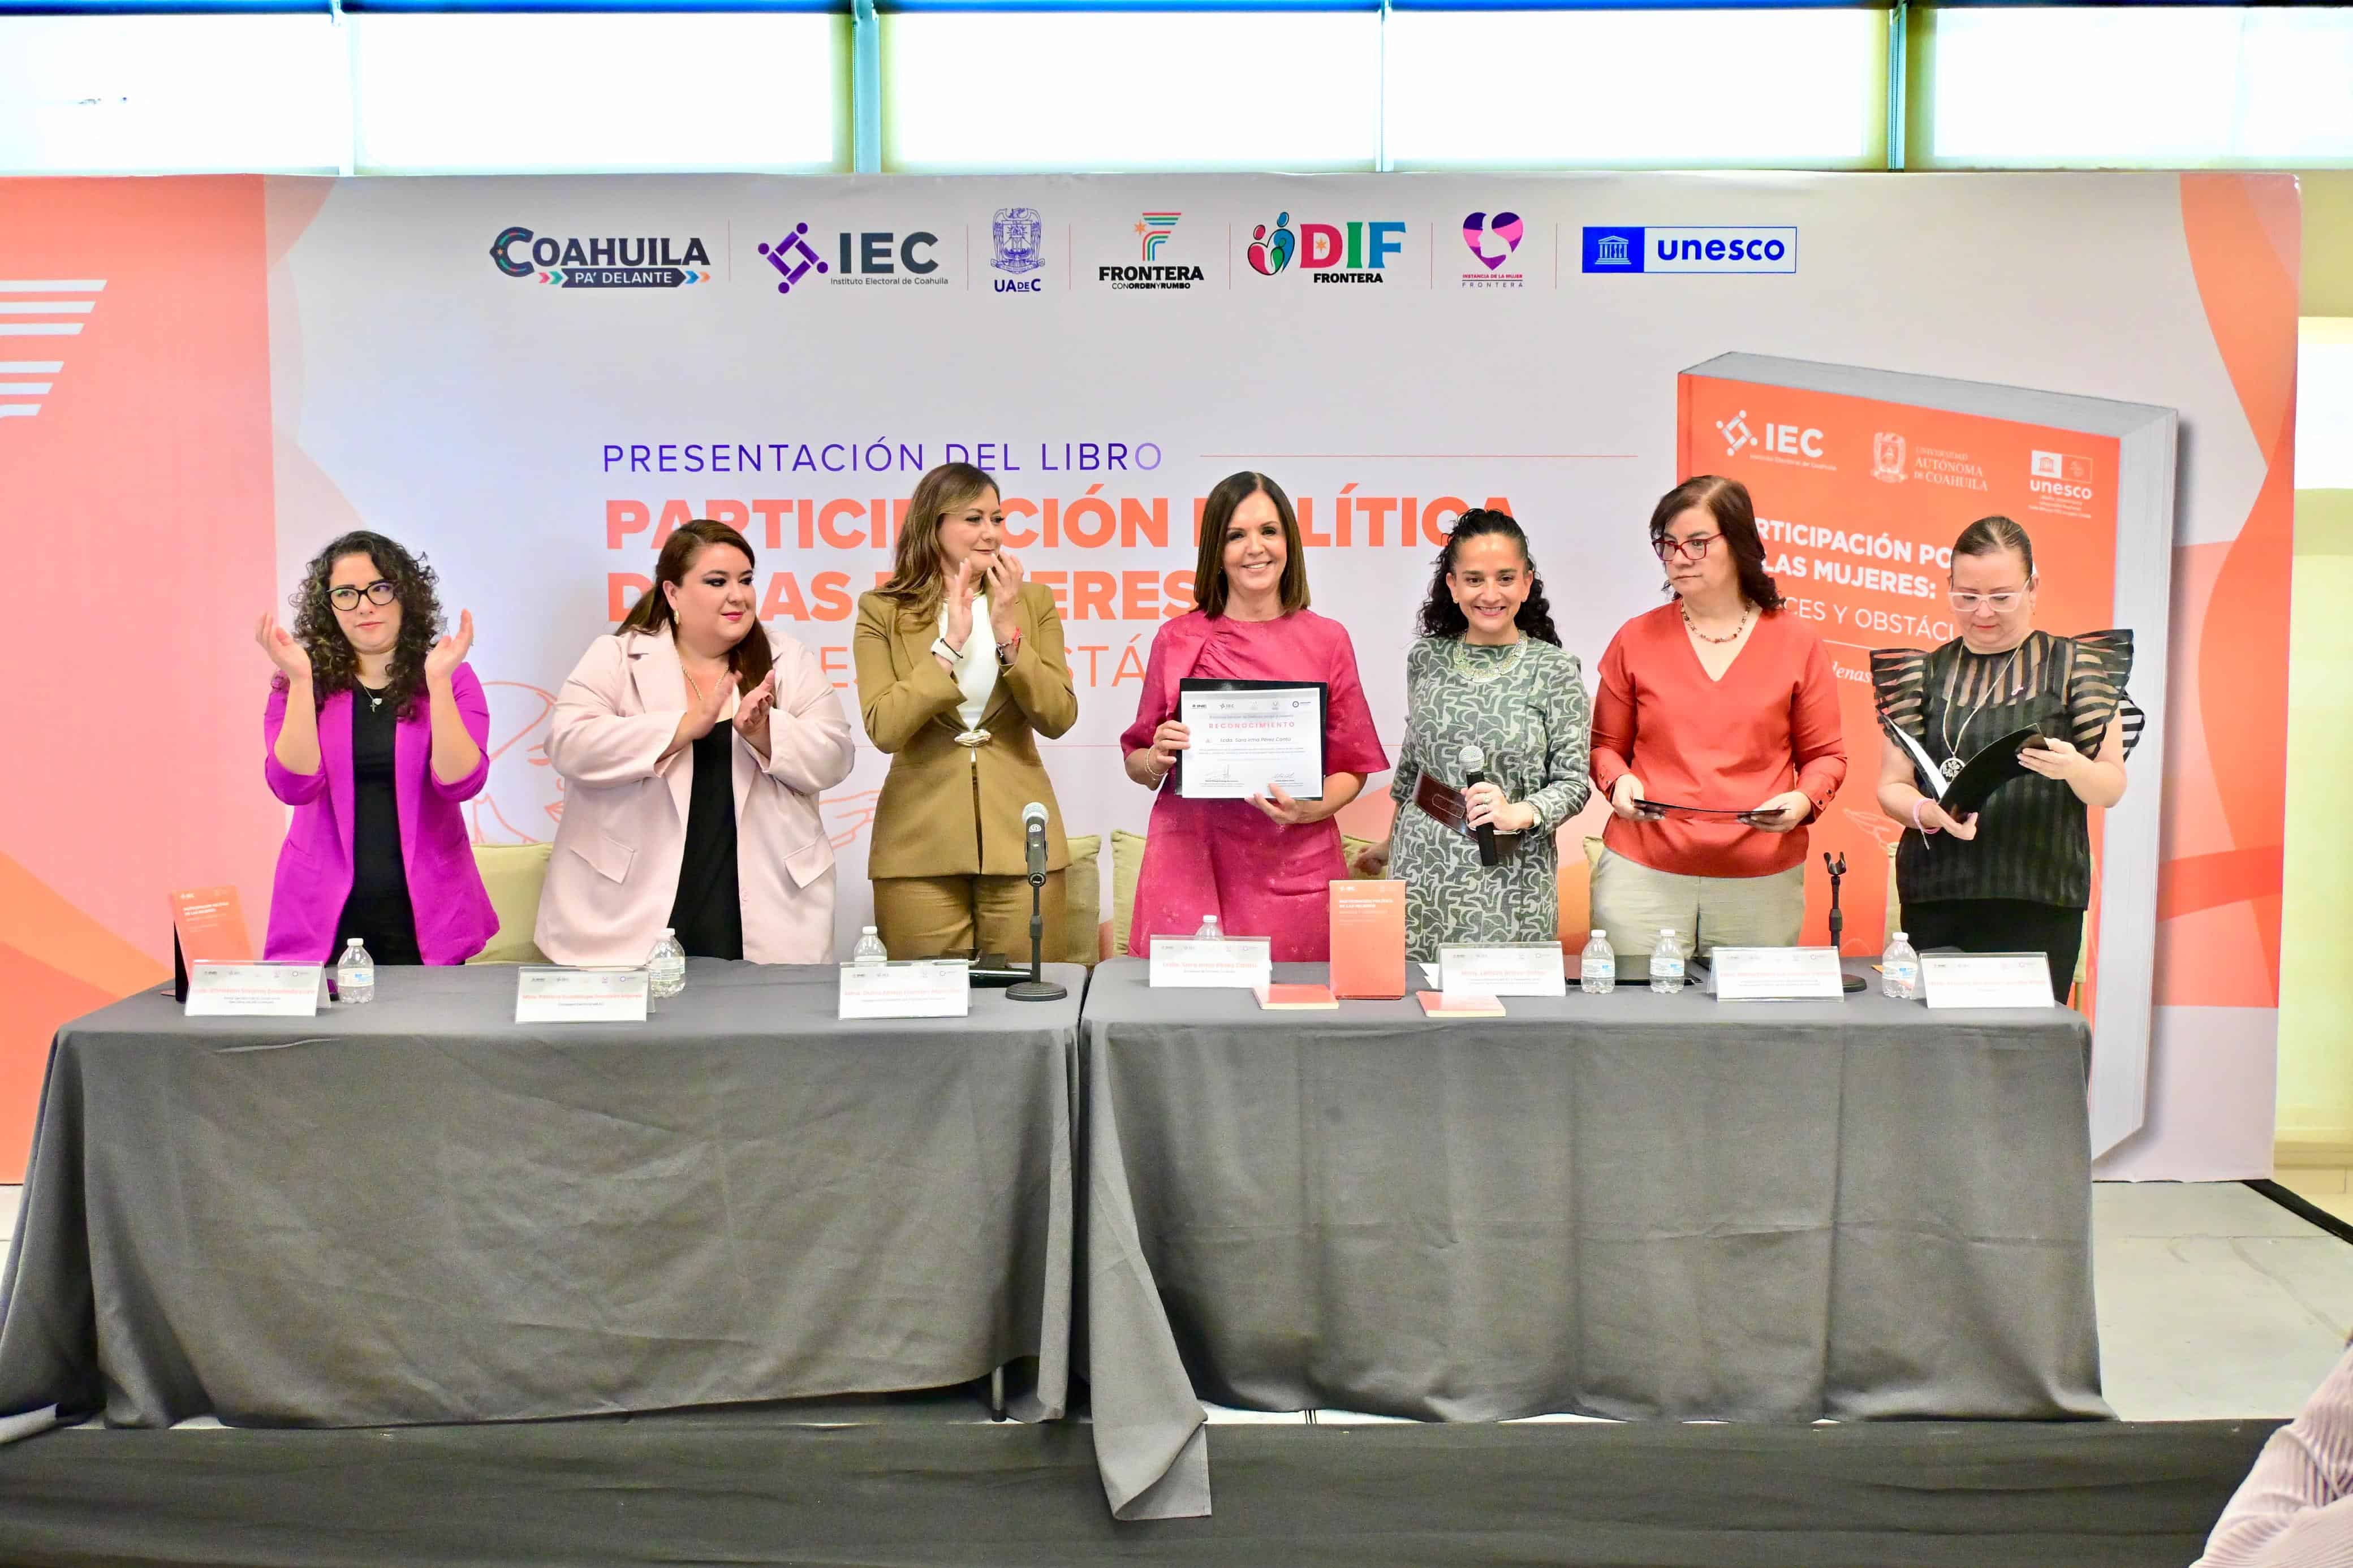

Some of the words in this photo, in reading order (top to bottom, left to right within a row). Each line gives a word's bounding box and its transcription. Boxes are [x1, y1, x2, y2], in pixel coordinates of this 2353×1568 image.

[489, 227, 710, 277] COAHUILA
[840, 232, 939, 274] IEC
[1300, 222, 1406, 269] DIF
[1658, 239, 1785, 261] unesco
[602, 271, 672, 283] DELANTE
[1099, 266, 1204, 280] FRONTERA
[1313, 273, 1383, 283] FRONTERA
[604, 437, 923, 472] PRESENTACIÓN
[946, 443, 1020, 471] DEL
[1042, 443, 1161, 471] LIBRO
[1766, 423, 1824, 458] IEC
[1915, 457, 1983, 477] AUTÓNOMA
[1925, 472, 1988, 493] COAHUILA
[2029, 479, 2092, 500] unesco
[1194, 482, 1514, 547] LÍTIC
[1755, 517, 1912, 563] RTICIPACIÓN
[1813, 559, 1936, 599] MUJERES:
[760, 571, 853, 622] AS
[1833, 603, 1848, 624] Y
[1209, 721, 1295, 729] RECONOCIMIENTO
